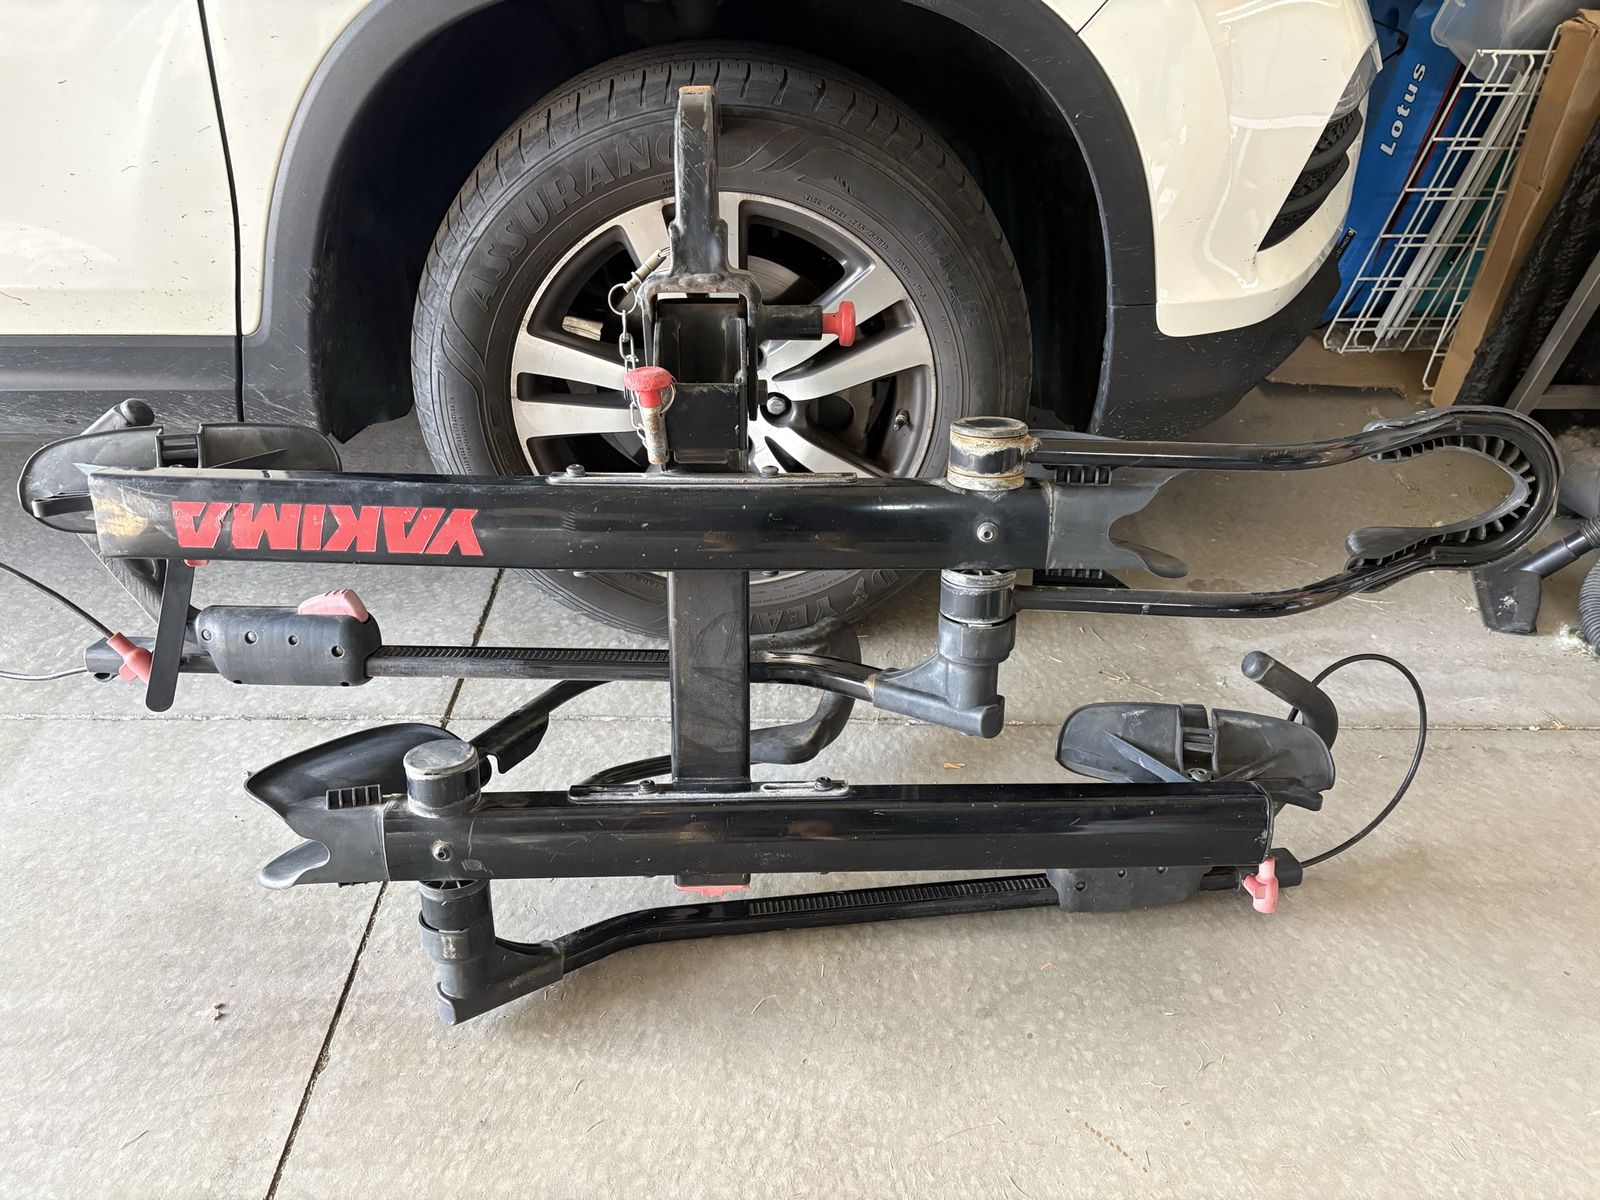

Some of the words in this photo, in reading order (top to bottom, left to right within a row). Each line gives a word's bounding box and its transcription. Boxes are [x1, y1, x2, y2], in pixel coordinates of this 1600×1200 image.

[1380, 63, 1426, 155] Lotus
[466, 131, 674, 312] ASSURANC
[171, 501, 483, 556] YAKIMA
